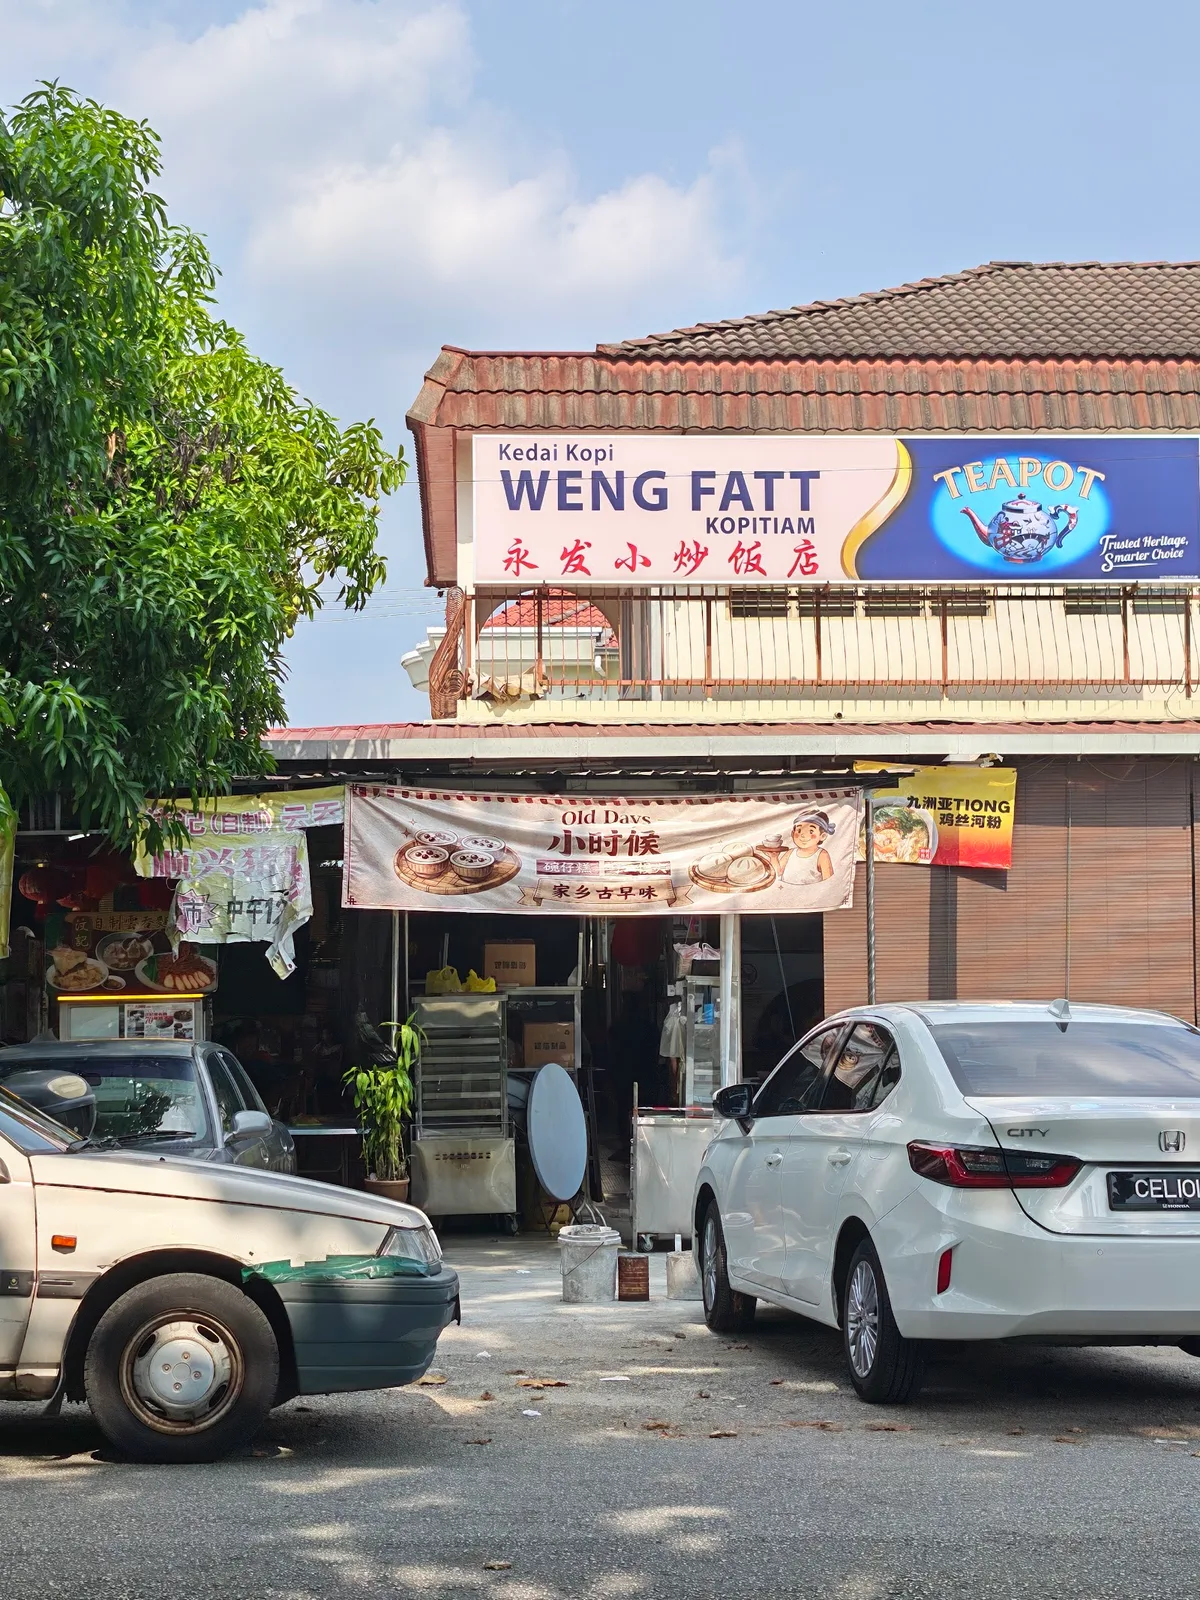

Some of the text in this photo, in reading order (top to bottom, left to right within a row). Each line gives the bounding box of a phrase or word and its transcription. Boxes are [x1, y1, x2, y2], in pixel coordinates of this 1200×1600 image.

[499, 443, 614, 465] Kedai Kopi
[933, 457, 1106, 500] TEAPOT
[500, 470, 821, 512] WENG FATT
[706, 517, 815, 534] KOPITIAM
[1099, 534, 1189, 556] Trusted Heritage,
[502, 538, 820, 578] 永发小炒饭店
[1101, 548, 1184, 572] Smarter Choice
[561, 809, 596, 825] Old
[939, 813, 1002, 829] 鸡丝河粉
[546, 829, 661, 857] 小时候
[552, 883, 659, 900] 家乡古早味
[1007, 1128, 1050, 1138] CITY
